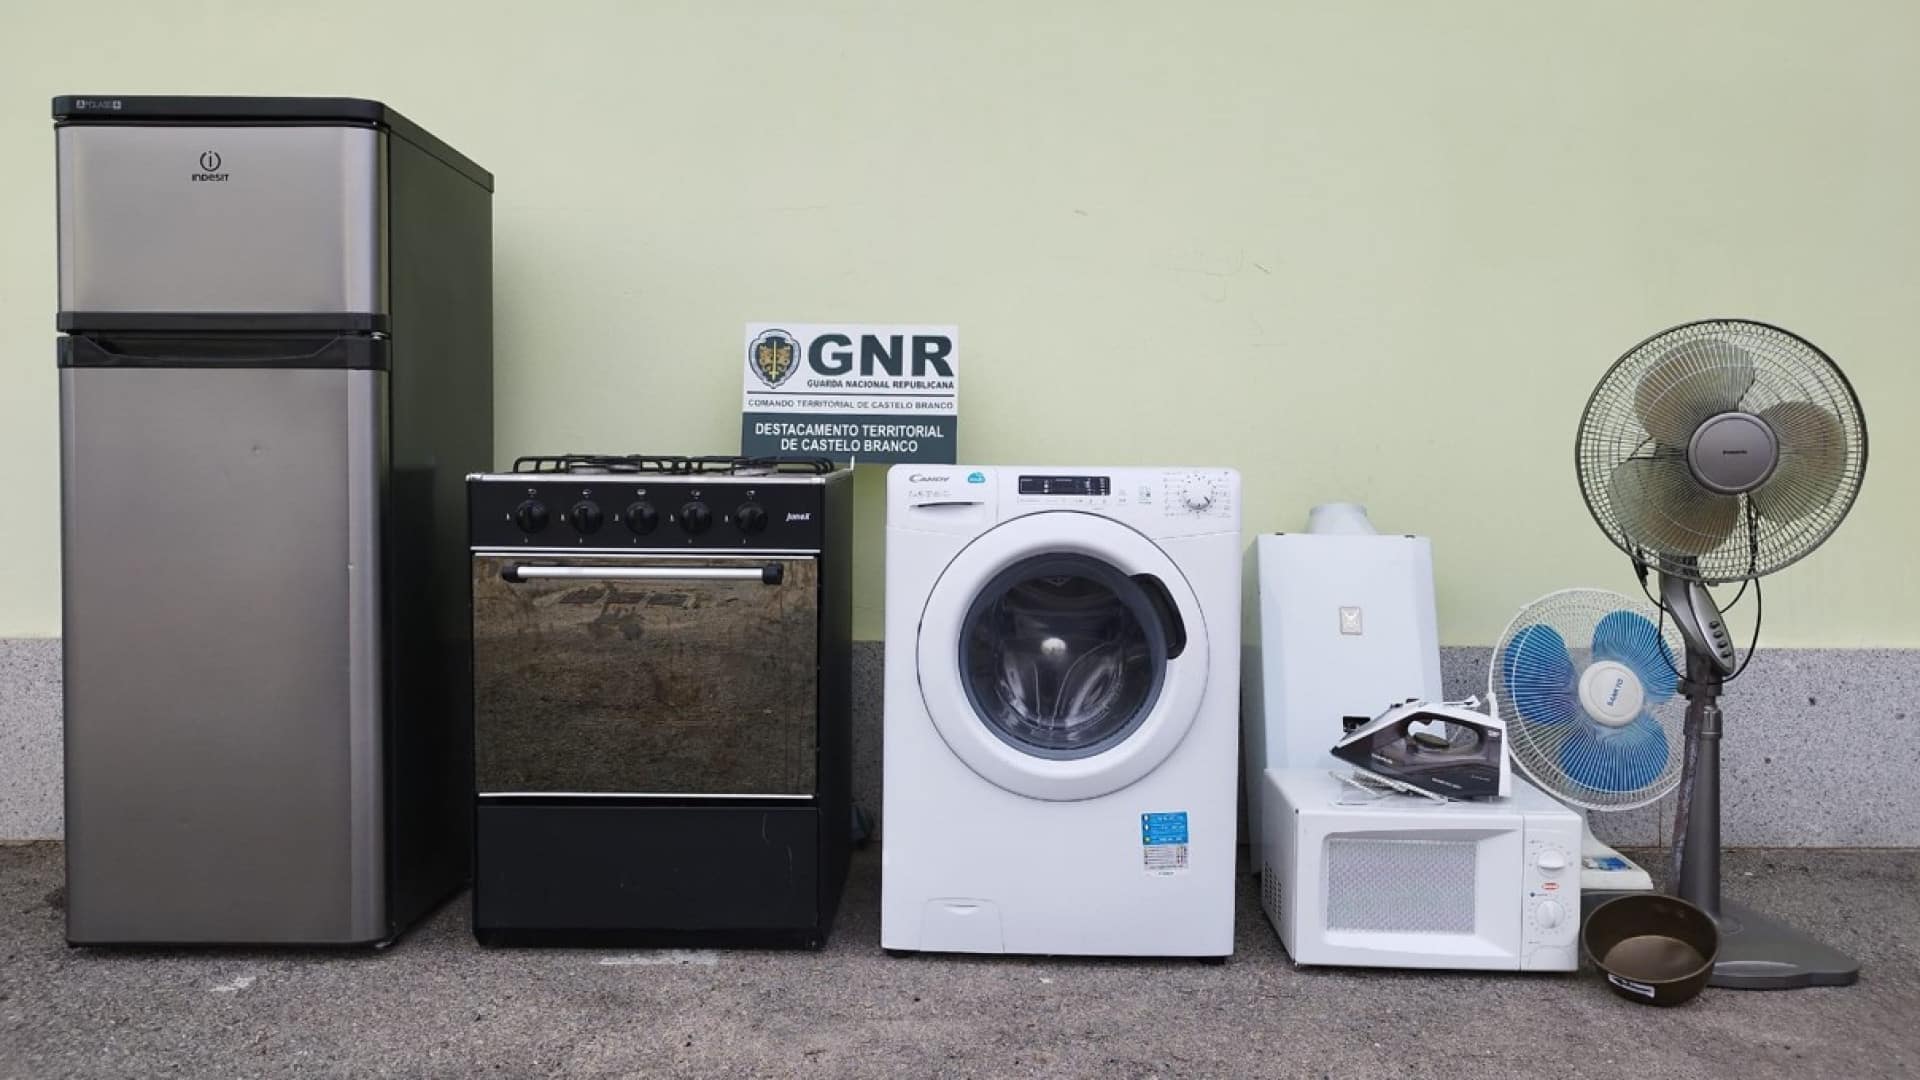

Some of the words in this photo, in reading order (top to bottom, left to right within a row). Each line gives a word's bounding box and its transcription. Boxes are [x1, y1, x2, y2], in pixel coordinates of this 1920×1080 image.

[808, 333, 954, 377] GNR
[807, 379, 843, 388] GUARDA
[845, 380, 890, 389] NACIONAL
[892, 380, 954, 389] REPUBLICANA
[748, 399, 794, 408] COMANDO
[797, 399, 854, 409] TERRITORIAL
[857, 400, 870, 409] DE
[871, 400, 913, 409] CASTELO
[915, 401, 953, 409] BRANCO
[754, 423, 859, 437] DESTACAMENTO
[862, 424, 944, 438] TERRITORIAL
[781, 438, 798, 451] DE
[801, 438, 861, 452] CASTELO
[864, 440, 918, 452] BRANCO
